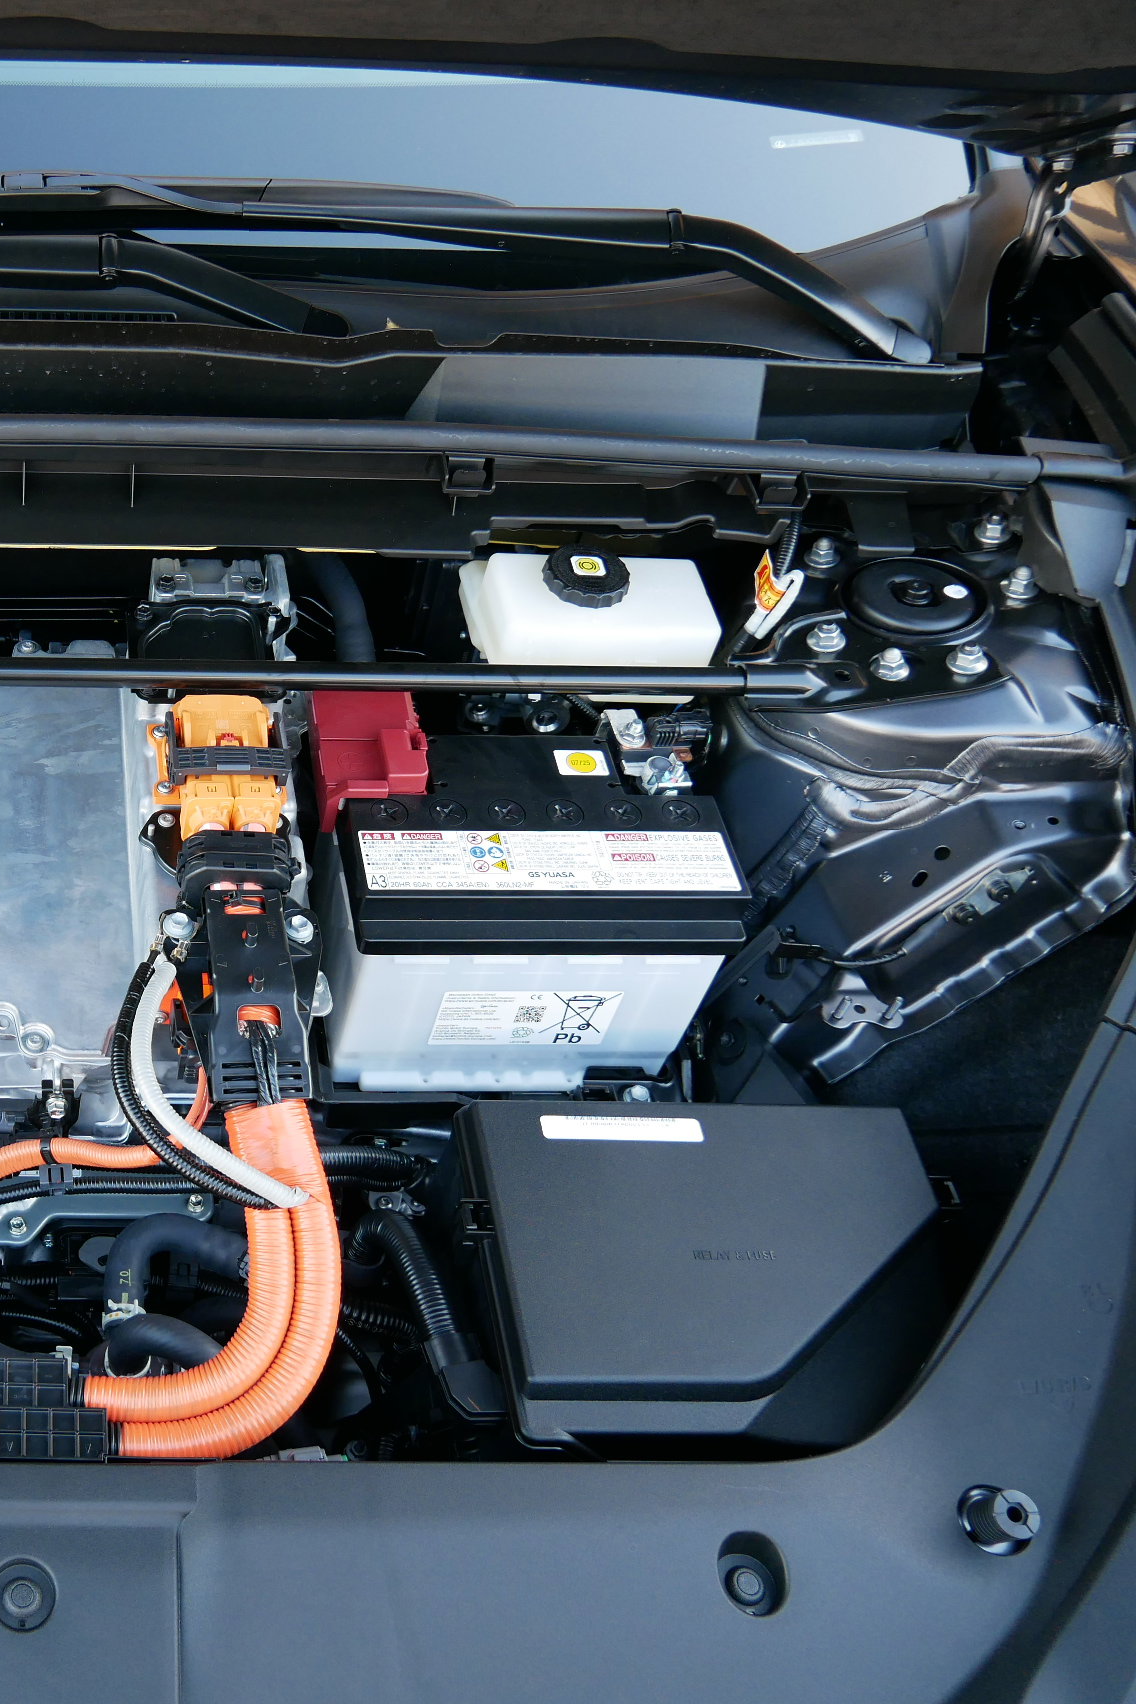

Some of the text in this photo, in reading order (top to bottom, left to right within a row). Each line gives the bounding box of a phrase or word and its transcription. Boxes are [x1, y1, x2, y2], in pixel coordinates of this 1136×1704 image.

[371, 875, 387, 888] A3
[552, 1033, 582, 1044] Pb
[693, 1250, 730, 1260] RELAY
[746, 1250, 776, 1260] FUSE
[120, 1271, 129, 1284] 70
